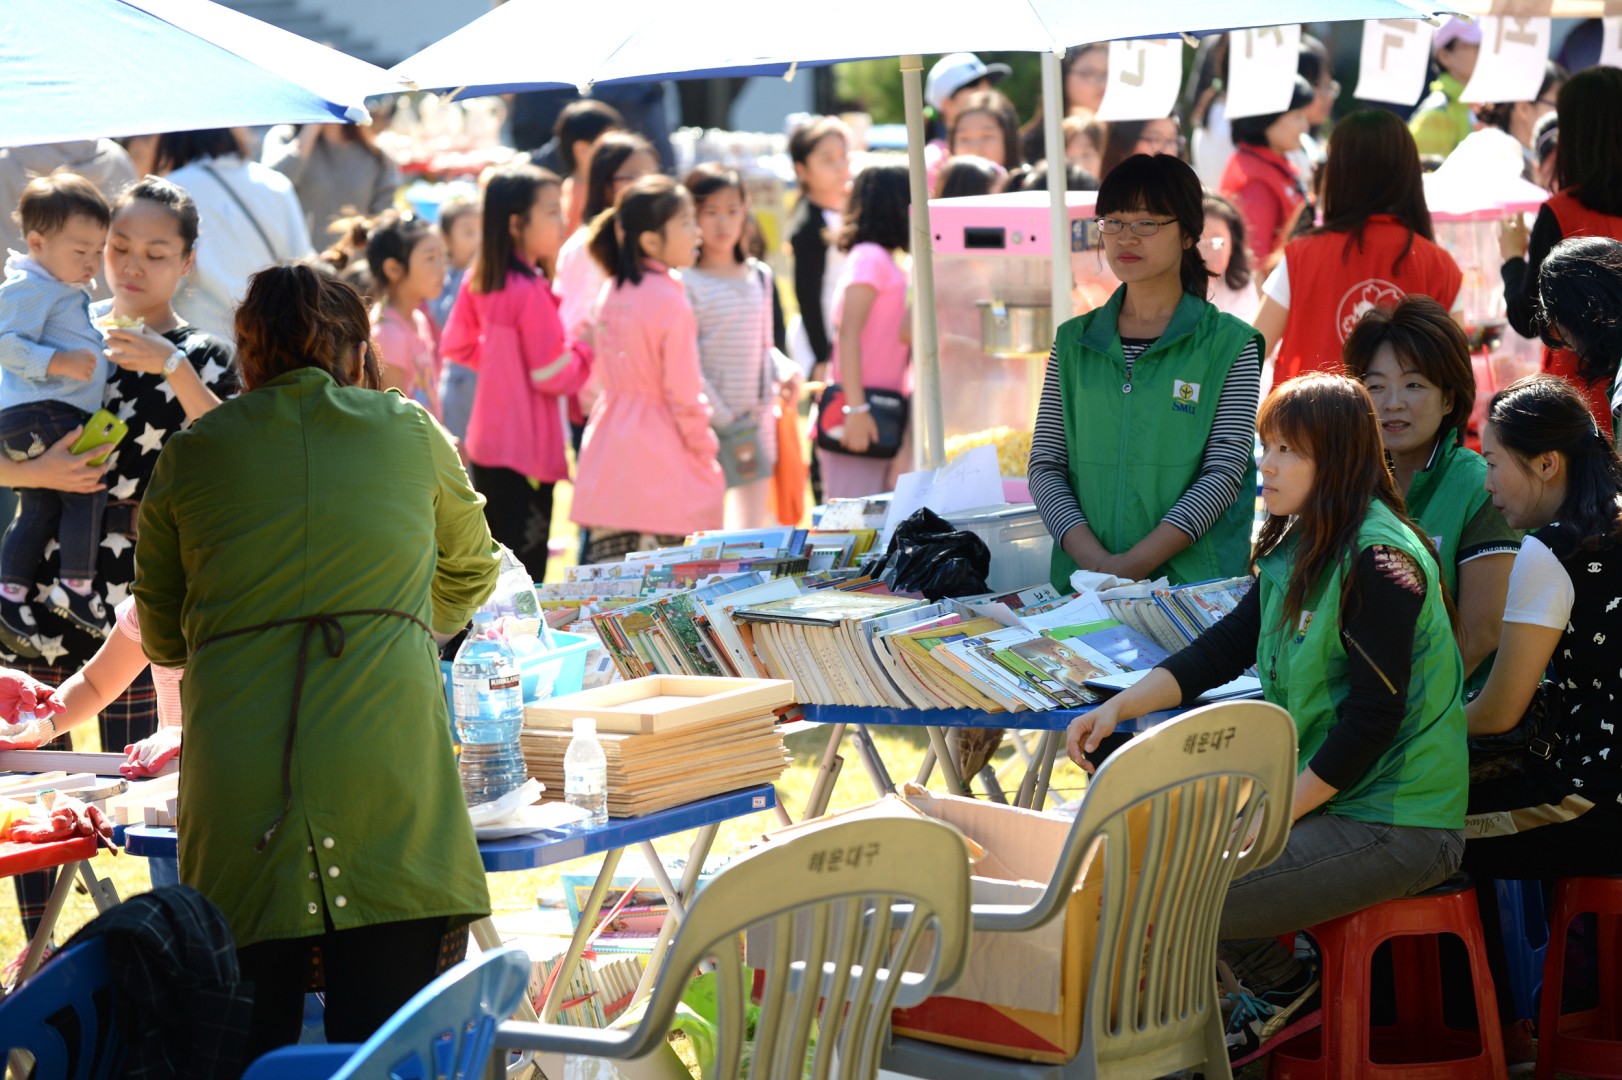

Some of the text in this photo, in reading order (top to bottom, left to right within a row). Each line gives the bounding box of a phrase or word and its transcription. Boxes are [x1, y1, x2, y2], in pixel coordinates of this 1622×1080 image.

[1171, 402, 1196, 415] SMU
[1183, 727, 1236, 754] 해운대구
[807, 842, 881, 873] 해운대구
